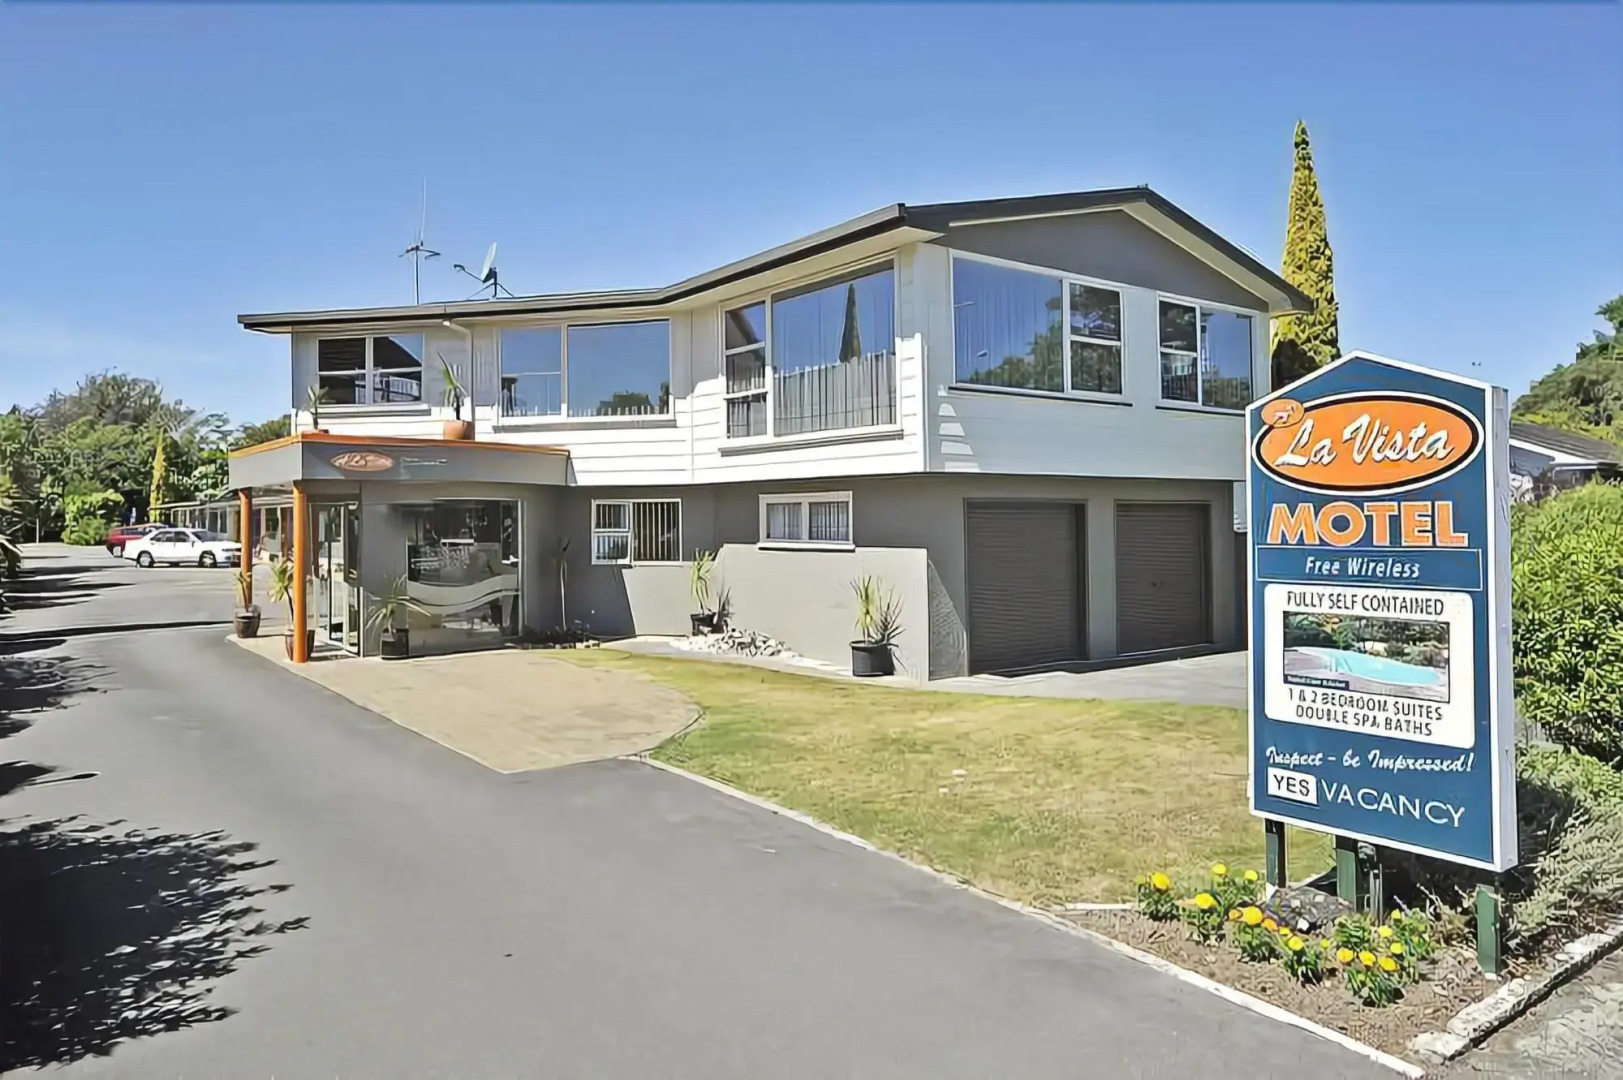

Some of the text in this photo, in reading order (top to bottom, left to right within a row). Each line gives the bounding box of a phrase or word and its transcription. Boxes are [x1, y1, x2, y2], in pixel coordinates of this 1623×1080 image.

[1274, 413, 1454, 467] La Vista
[1266, 501, 1469, 547] MOTEL
[1306, 556, 1420, 578] Free Wireless
[1287, 591, 1444, 616] FULLY SELF CONTAINED
[1288, 687, 1294, 701] 1
[1321, 692, 1389, 713] BEDROOM
[1392, 700, 1443, 721] SUITES
[1295, 704, 1349, 725] DOUBLE
[1384, 717, 1433, 737] BATHS
[1273, 773, 1466, 828] YES VACANCY
